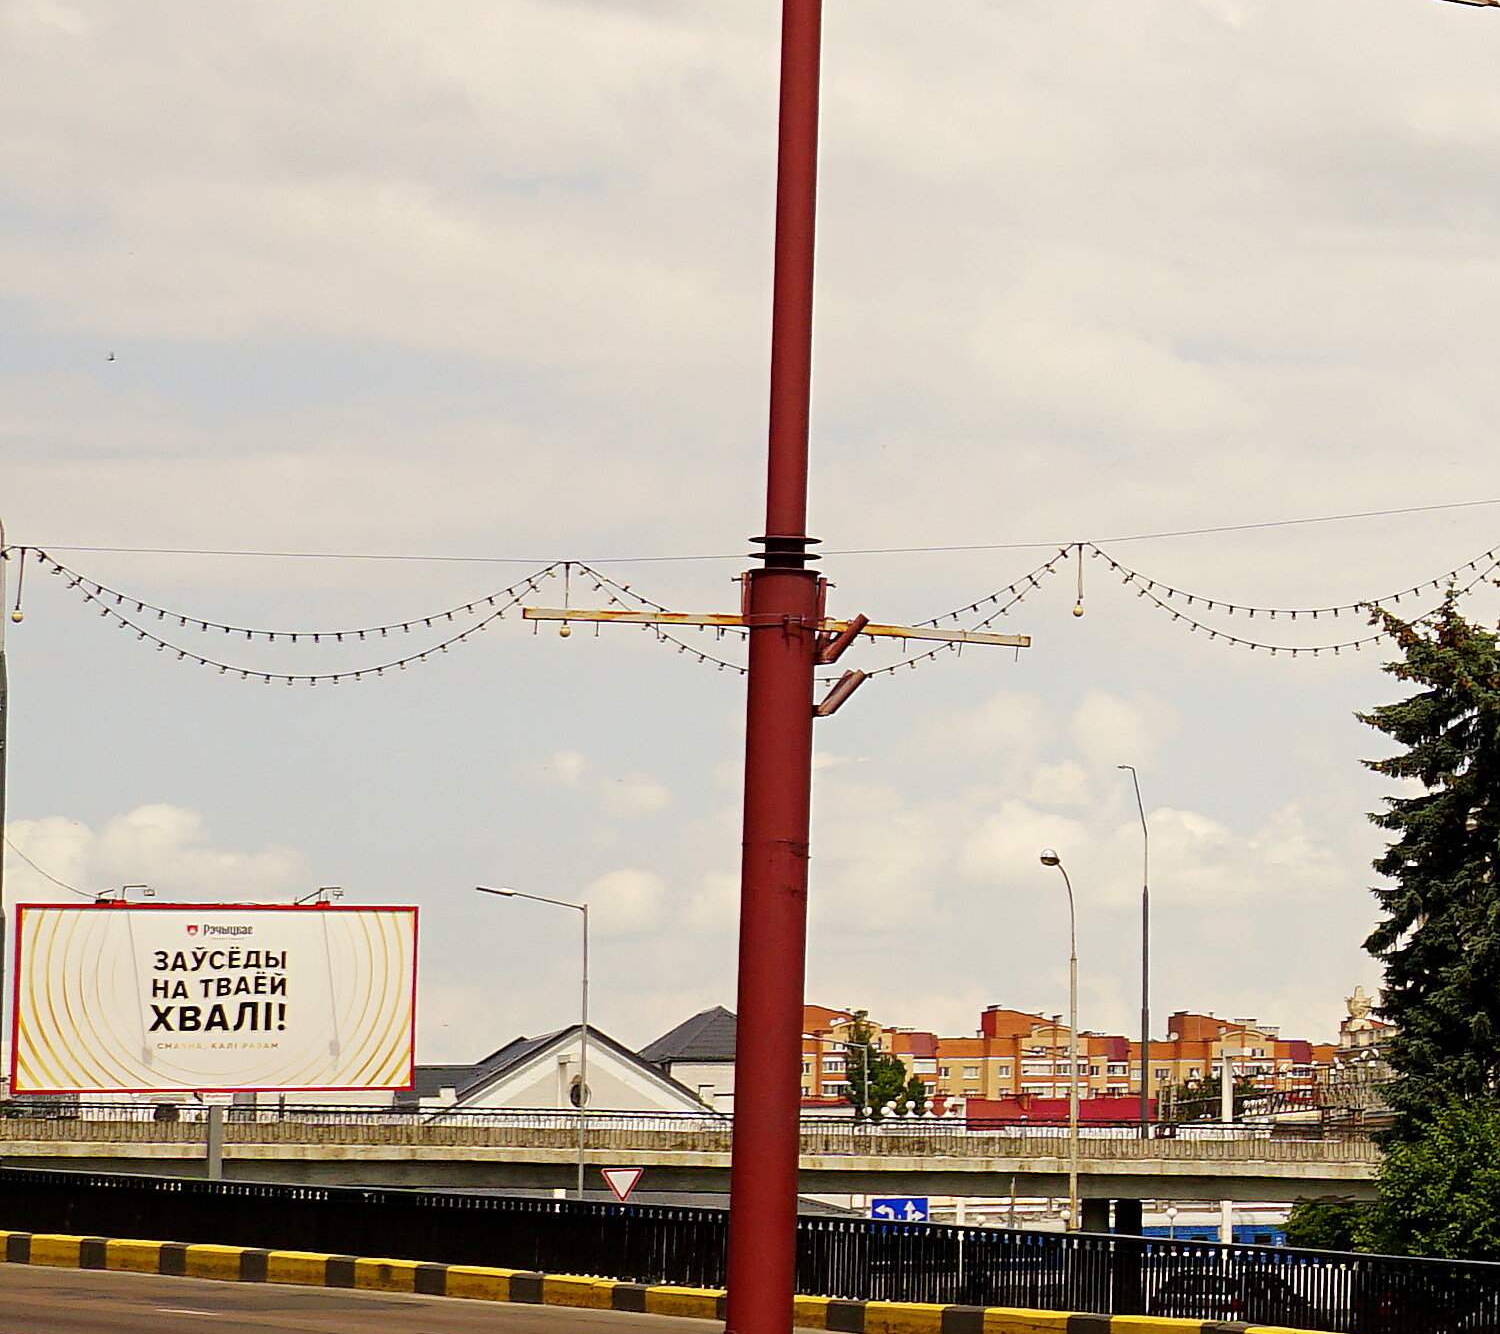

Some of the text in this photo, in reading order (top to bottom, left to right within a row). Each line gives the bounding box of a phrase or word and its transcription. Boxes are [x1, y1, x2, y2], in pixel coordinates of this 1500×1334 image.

[153, 946, 287, 971] ЗАЎСЁДЫ
[152, 972, 287, 999] НА ТВАЁЙ
[148, 1001, 286, 1032] ХВАЛІ!
